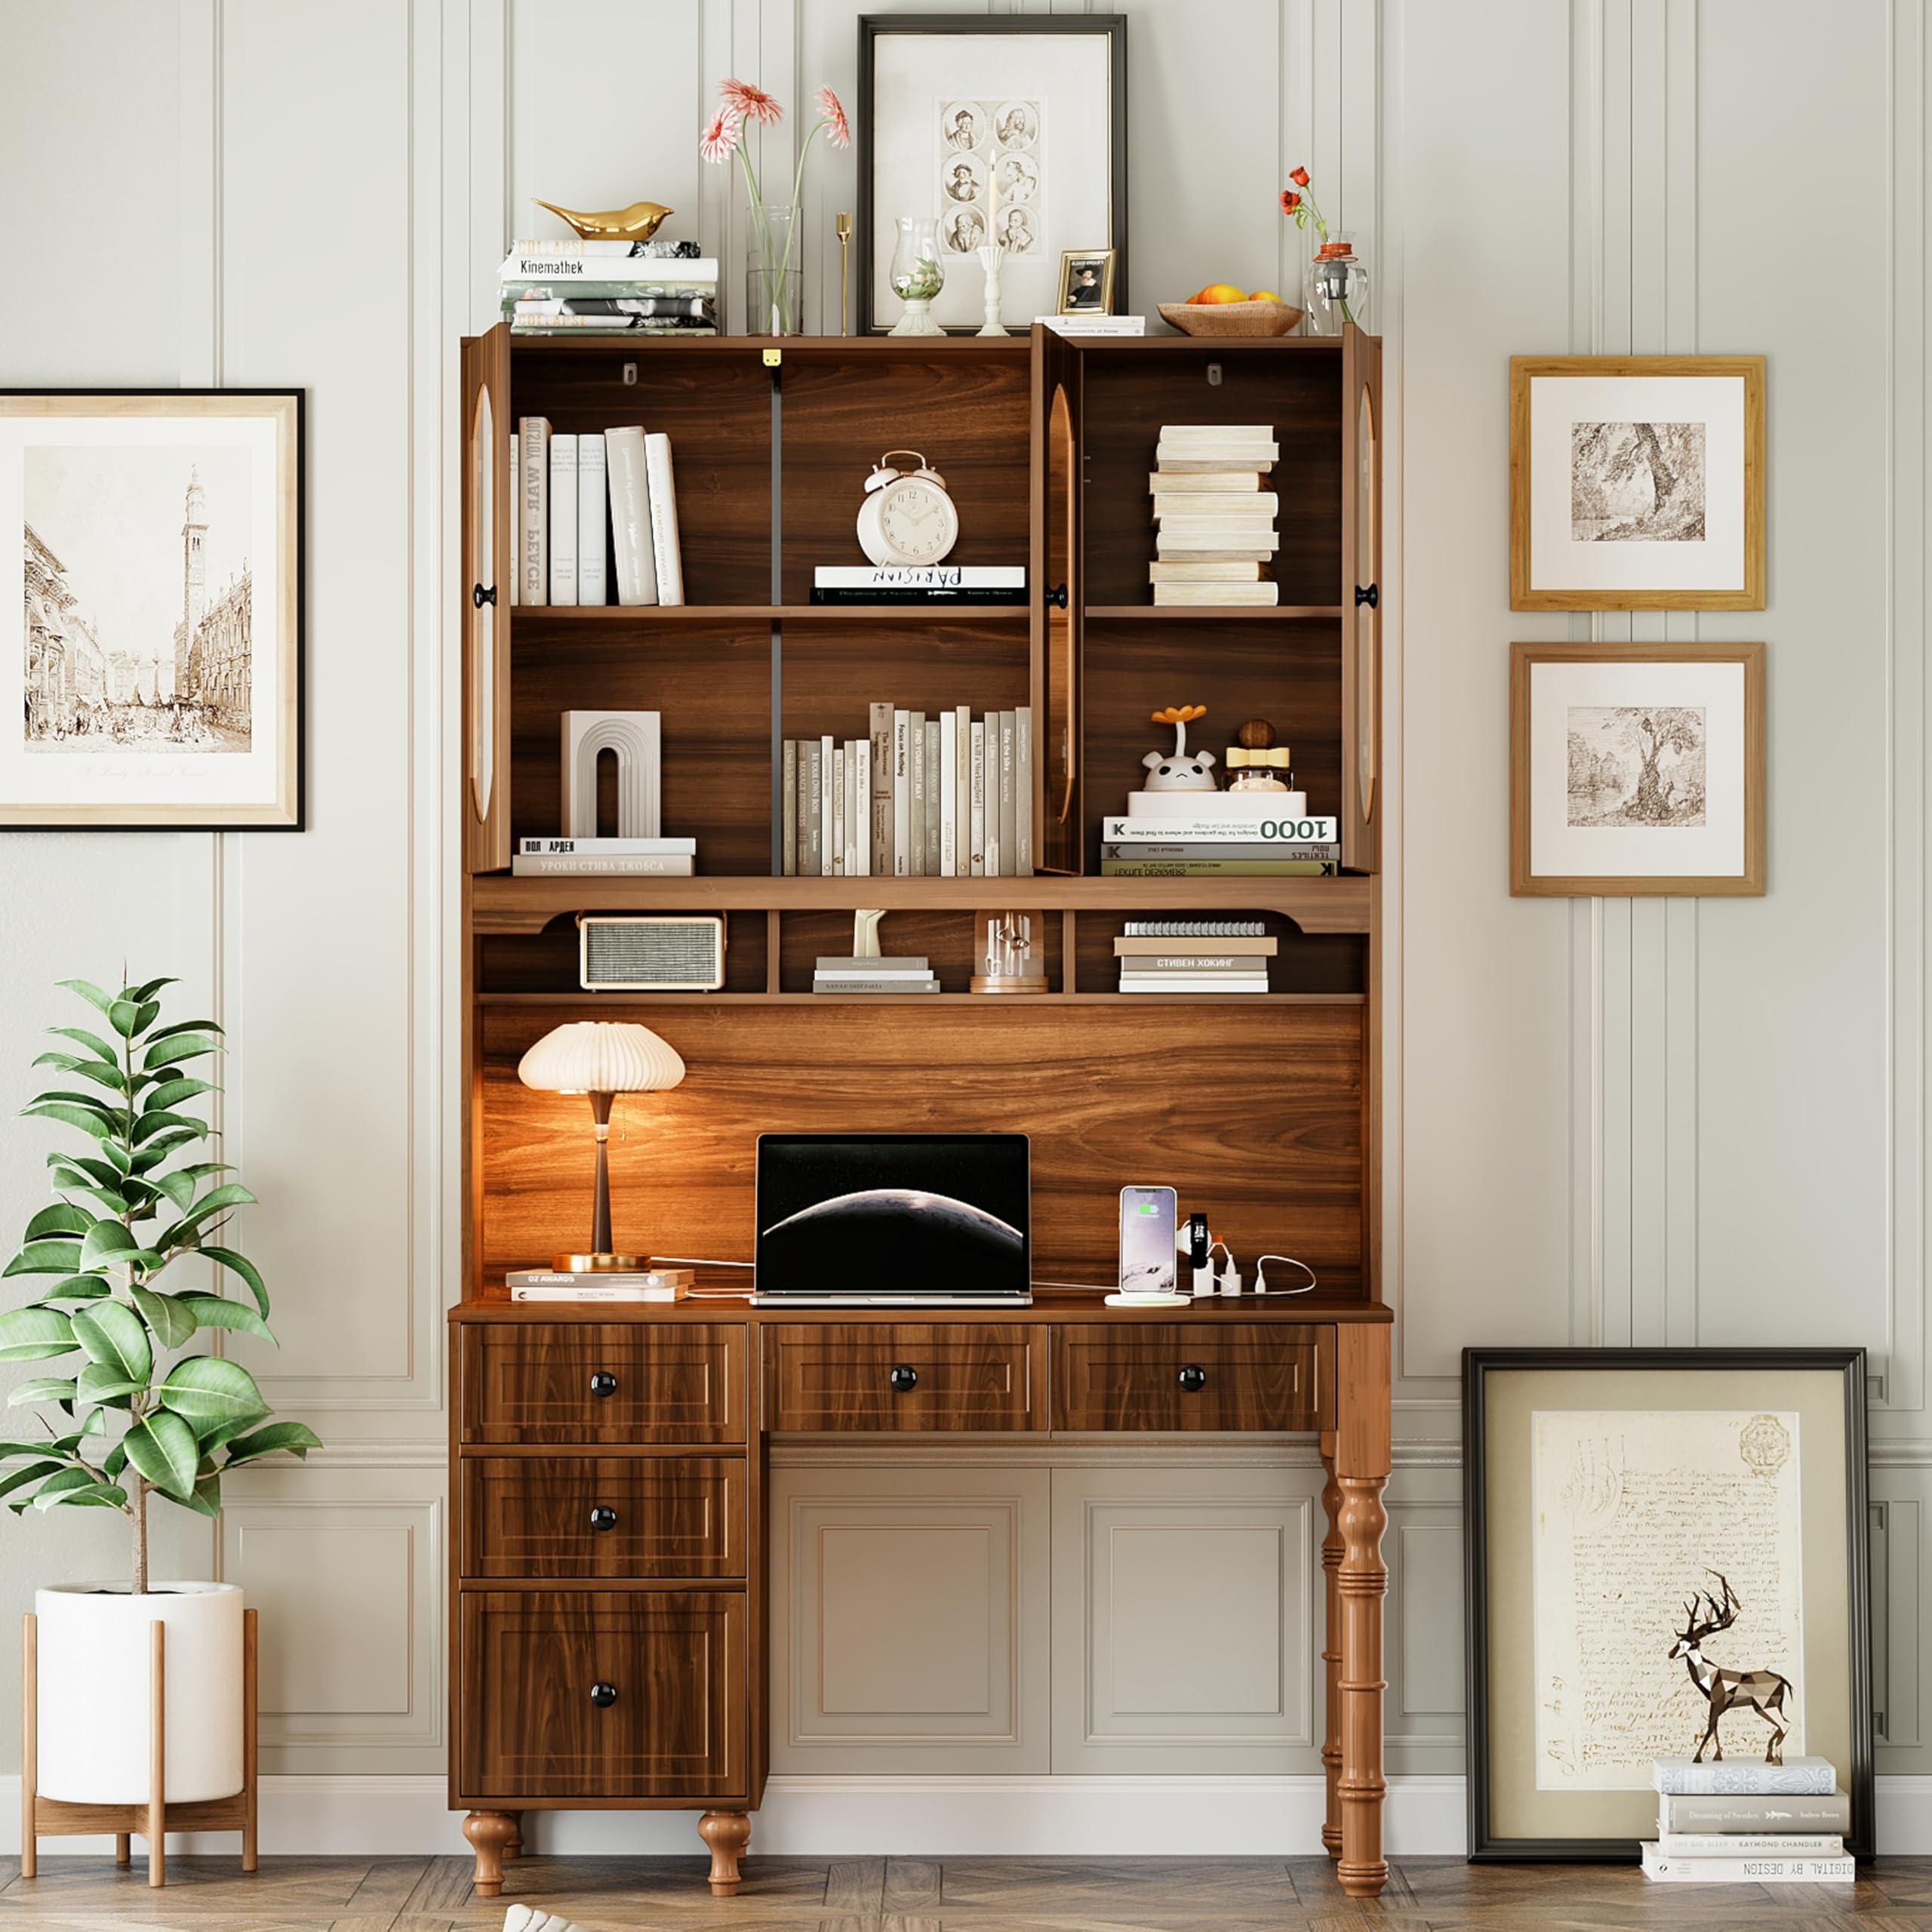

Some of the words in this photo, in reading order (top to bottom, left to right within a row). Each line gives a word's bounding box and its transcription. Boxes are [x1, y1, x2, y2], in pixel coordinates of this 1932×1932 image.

[521, 260, 583, 275] Kinemathek
[873, 568, 961, 589] PARISIAN
[898, 743, 904, 751] on
[897, 752, 906, 777] Nothing
[1260, 820, 1327, 838] 1000
[525, 841, 541, 852] ПОЛ
[549, 841, 574, 853] АРДЕН
[540, 861, 577, 871] УРОКИ
[579, 861, 615, 871] СТИВА
[617, 861, 664, 872] ДЖОБСА
[1157, 958, 1195, 968] СТИВЕН
[1197, 958, 1234, 968] ХОКИНГ
[1688, 1810, 1723, 1820] Dreaming
[1732, 1810, 1759, 1819] Sweden
[1743, 1863, 1783, 1875] DESIGN
[1791, 1863, 1803, 1875] BY
[1811, 1863, 1854, 1875] DIGITAL
